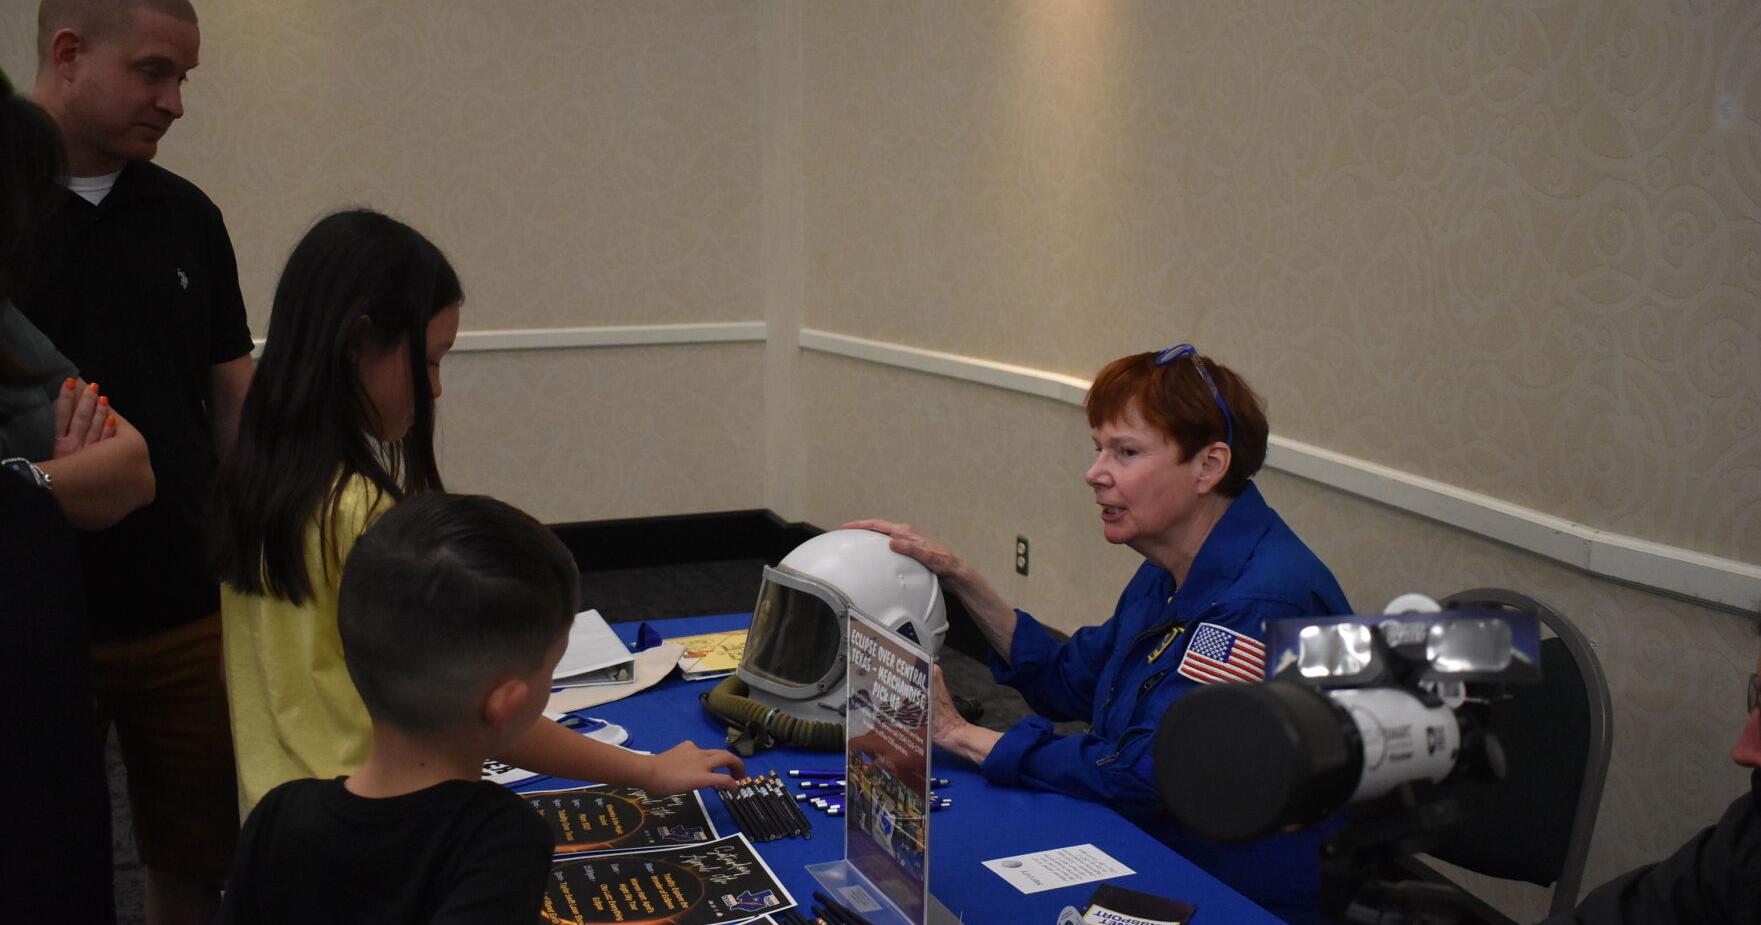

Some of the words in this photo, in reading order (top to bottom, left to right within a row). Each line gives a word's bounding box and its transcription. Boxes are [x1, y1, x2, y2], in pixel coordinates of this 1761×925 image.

[851, 629, 878, 657] ECLIPSE
[878, 646, 896, 669] OVER
[896, 658, 926, 690] CENTRAL
[851, 648, 872, 671] TEXAS
[878, 666, 927, 710] MERCHANDISE
[872, 682, 889, 704] PICK
